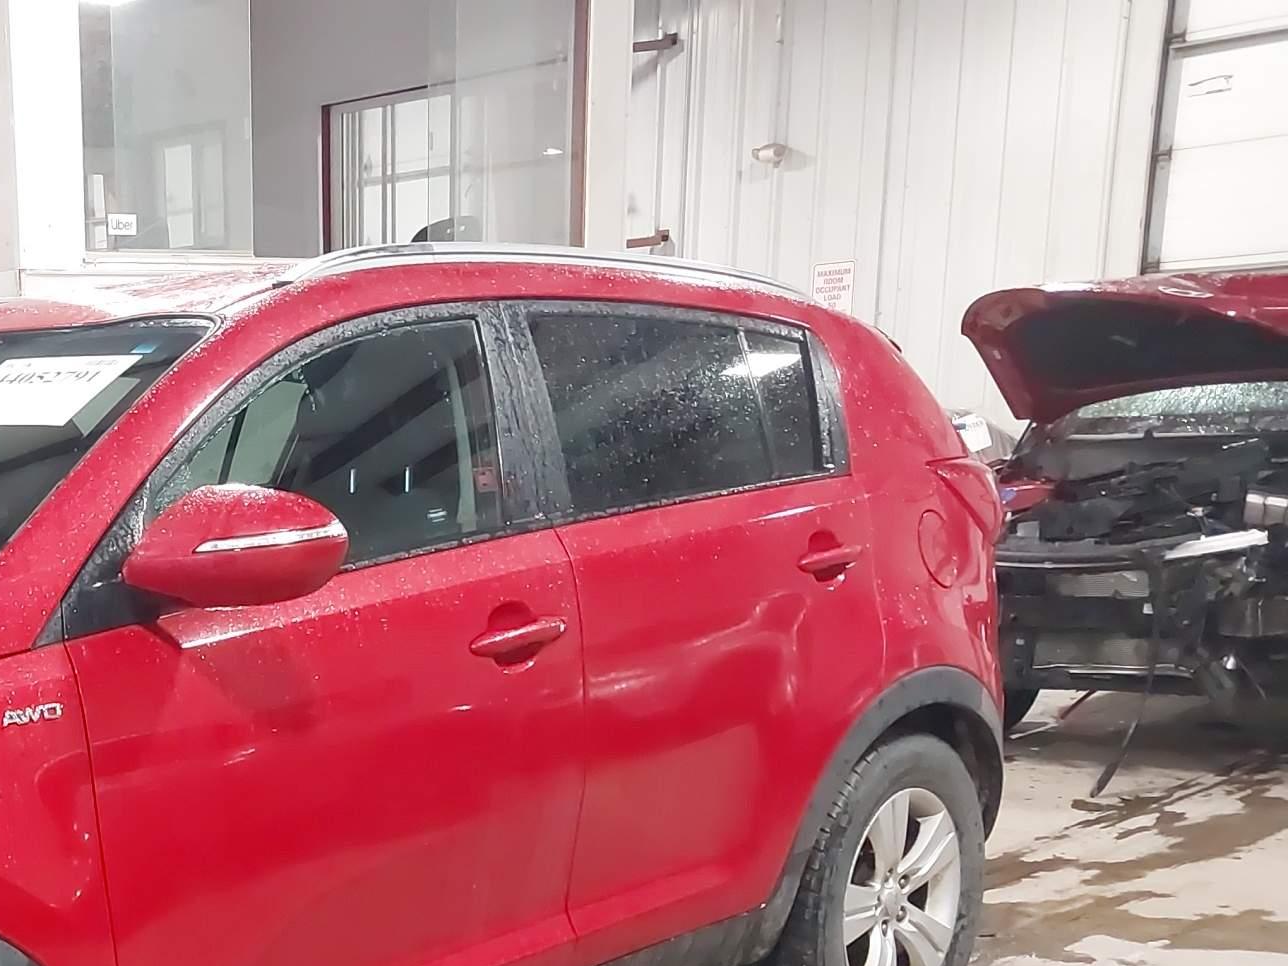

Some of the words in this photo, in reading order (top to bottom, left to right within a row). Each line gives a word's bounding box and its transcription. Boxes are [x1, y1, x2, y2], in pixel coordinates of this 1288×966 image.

[110, 218, 133, 230] Uber
[817, 268, 851, 277] MAXIMUM
[823, 277, 844, 285] ROOM
[815, 284, 850, 294] OCCUPANT
[823, 293, 842, 302] LOAD
[2, 702, 63, 728] AWD
